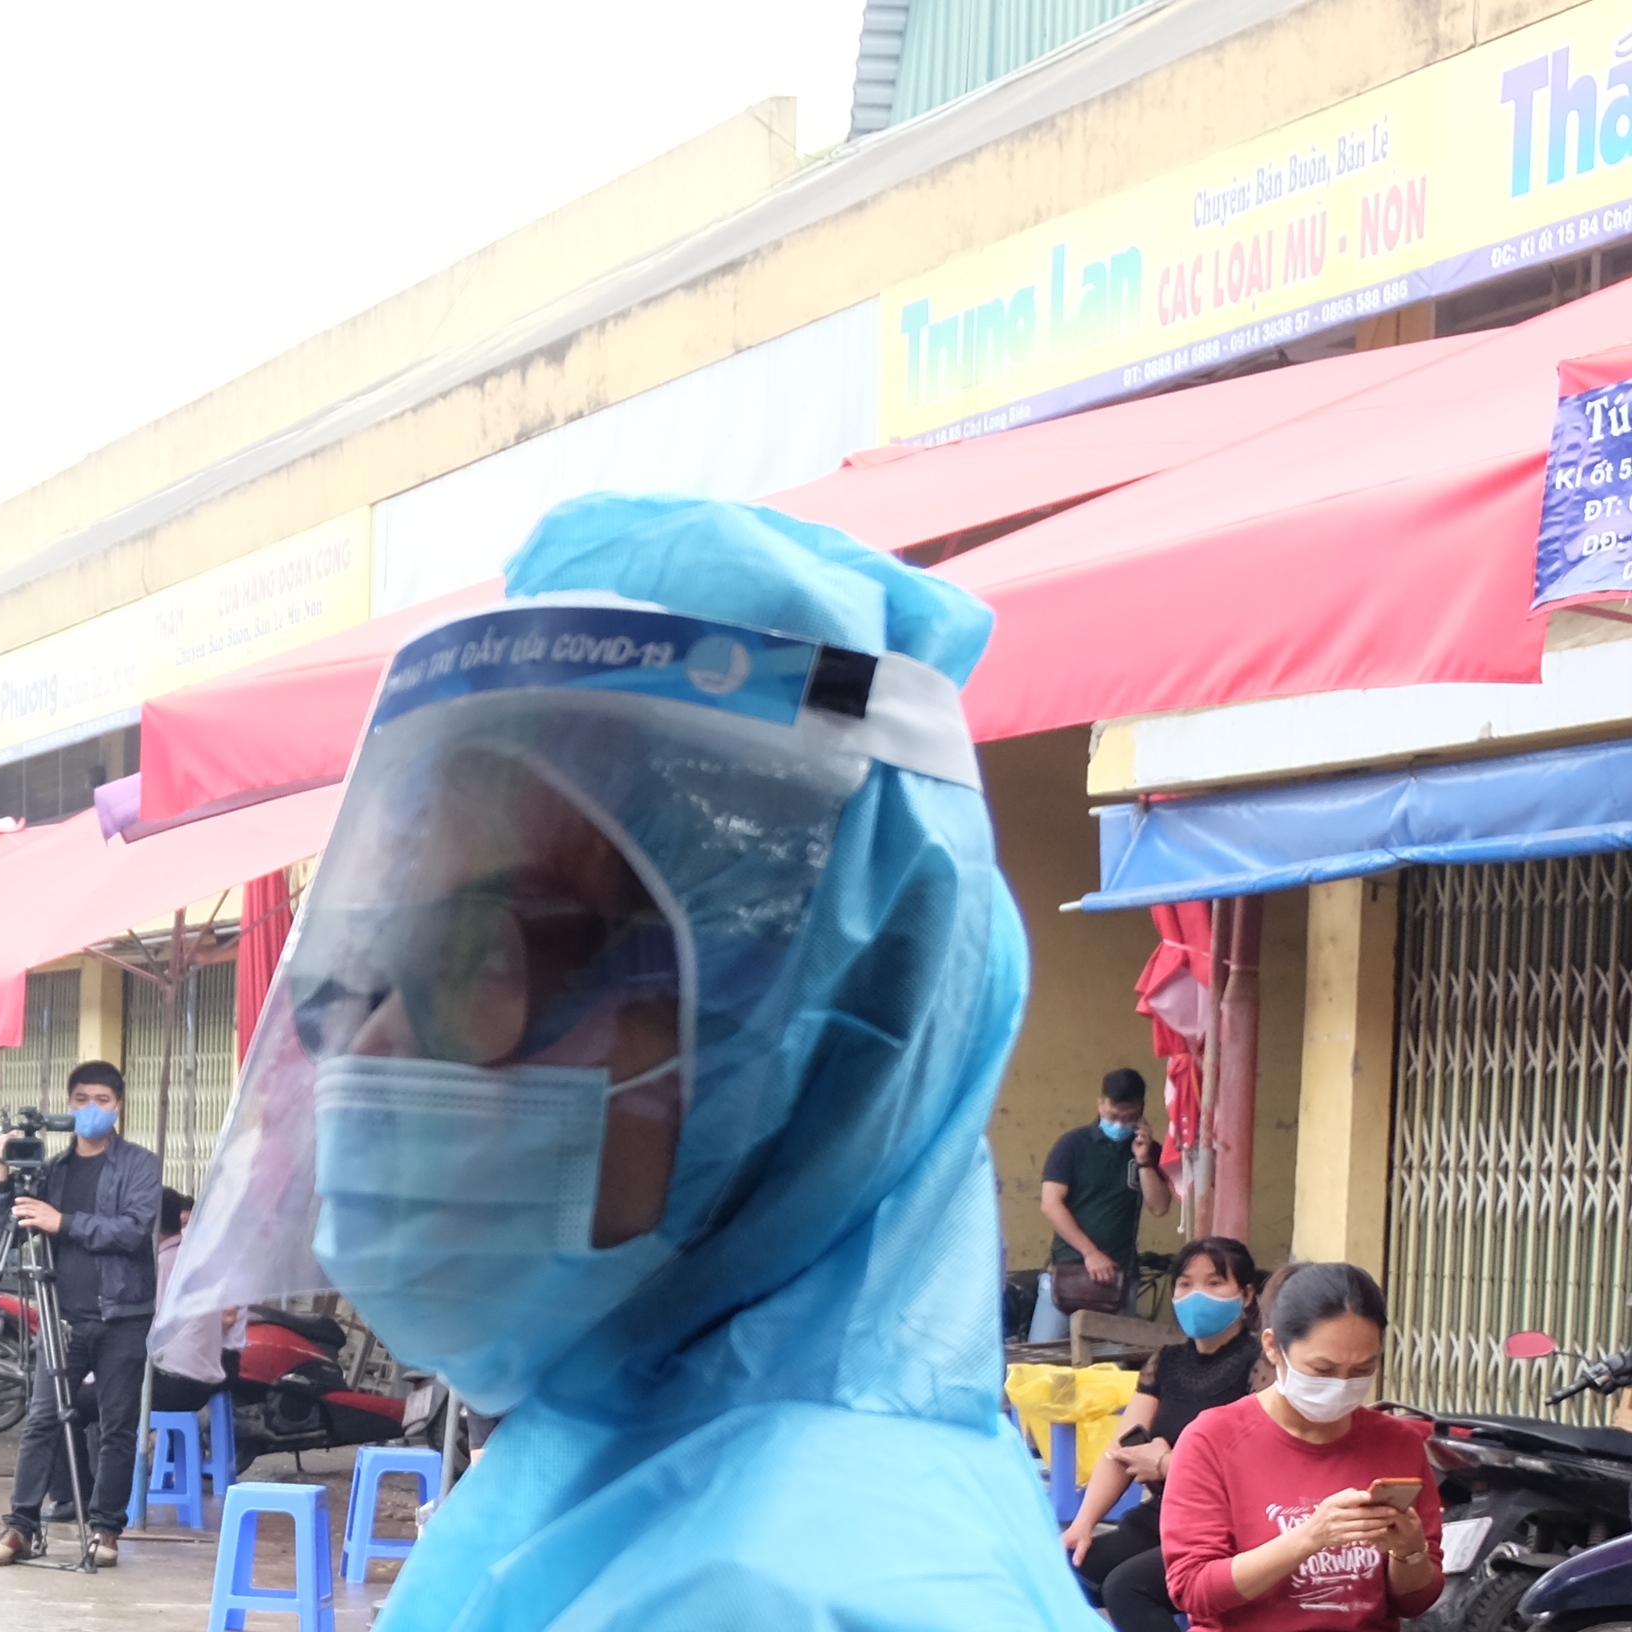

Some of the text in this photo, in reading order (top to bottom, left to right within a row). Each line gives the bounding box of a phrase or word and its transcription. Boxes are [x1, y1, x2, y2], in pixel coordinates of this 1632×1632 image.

[1556, 222, 1575, 247] 15
[1579, 214, 1599, 241] B4
[1049, 243, 1142, 350] Lan
[551, 632, 675, 669] COVID-19
